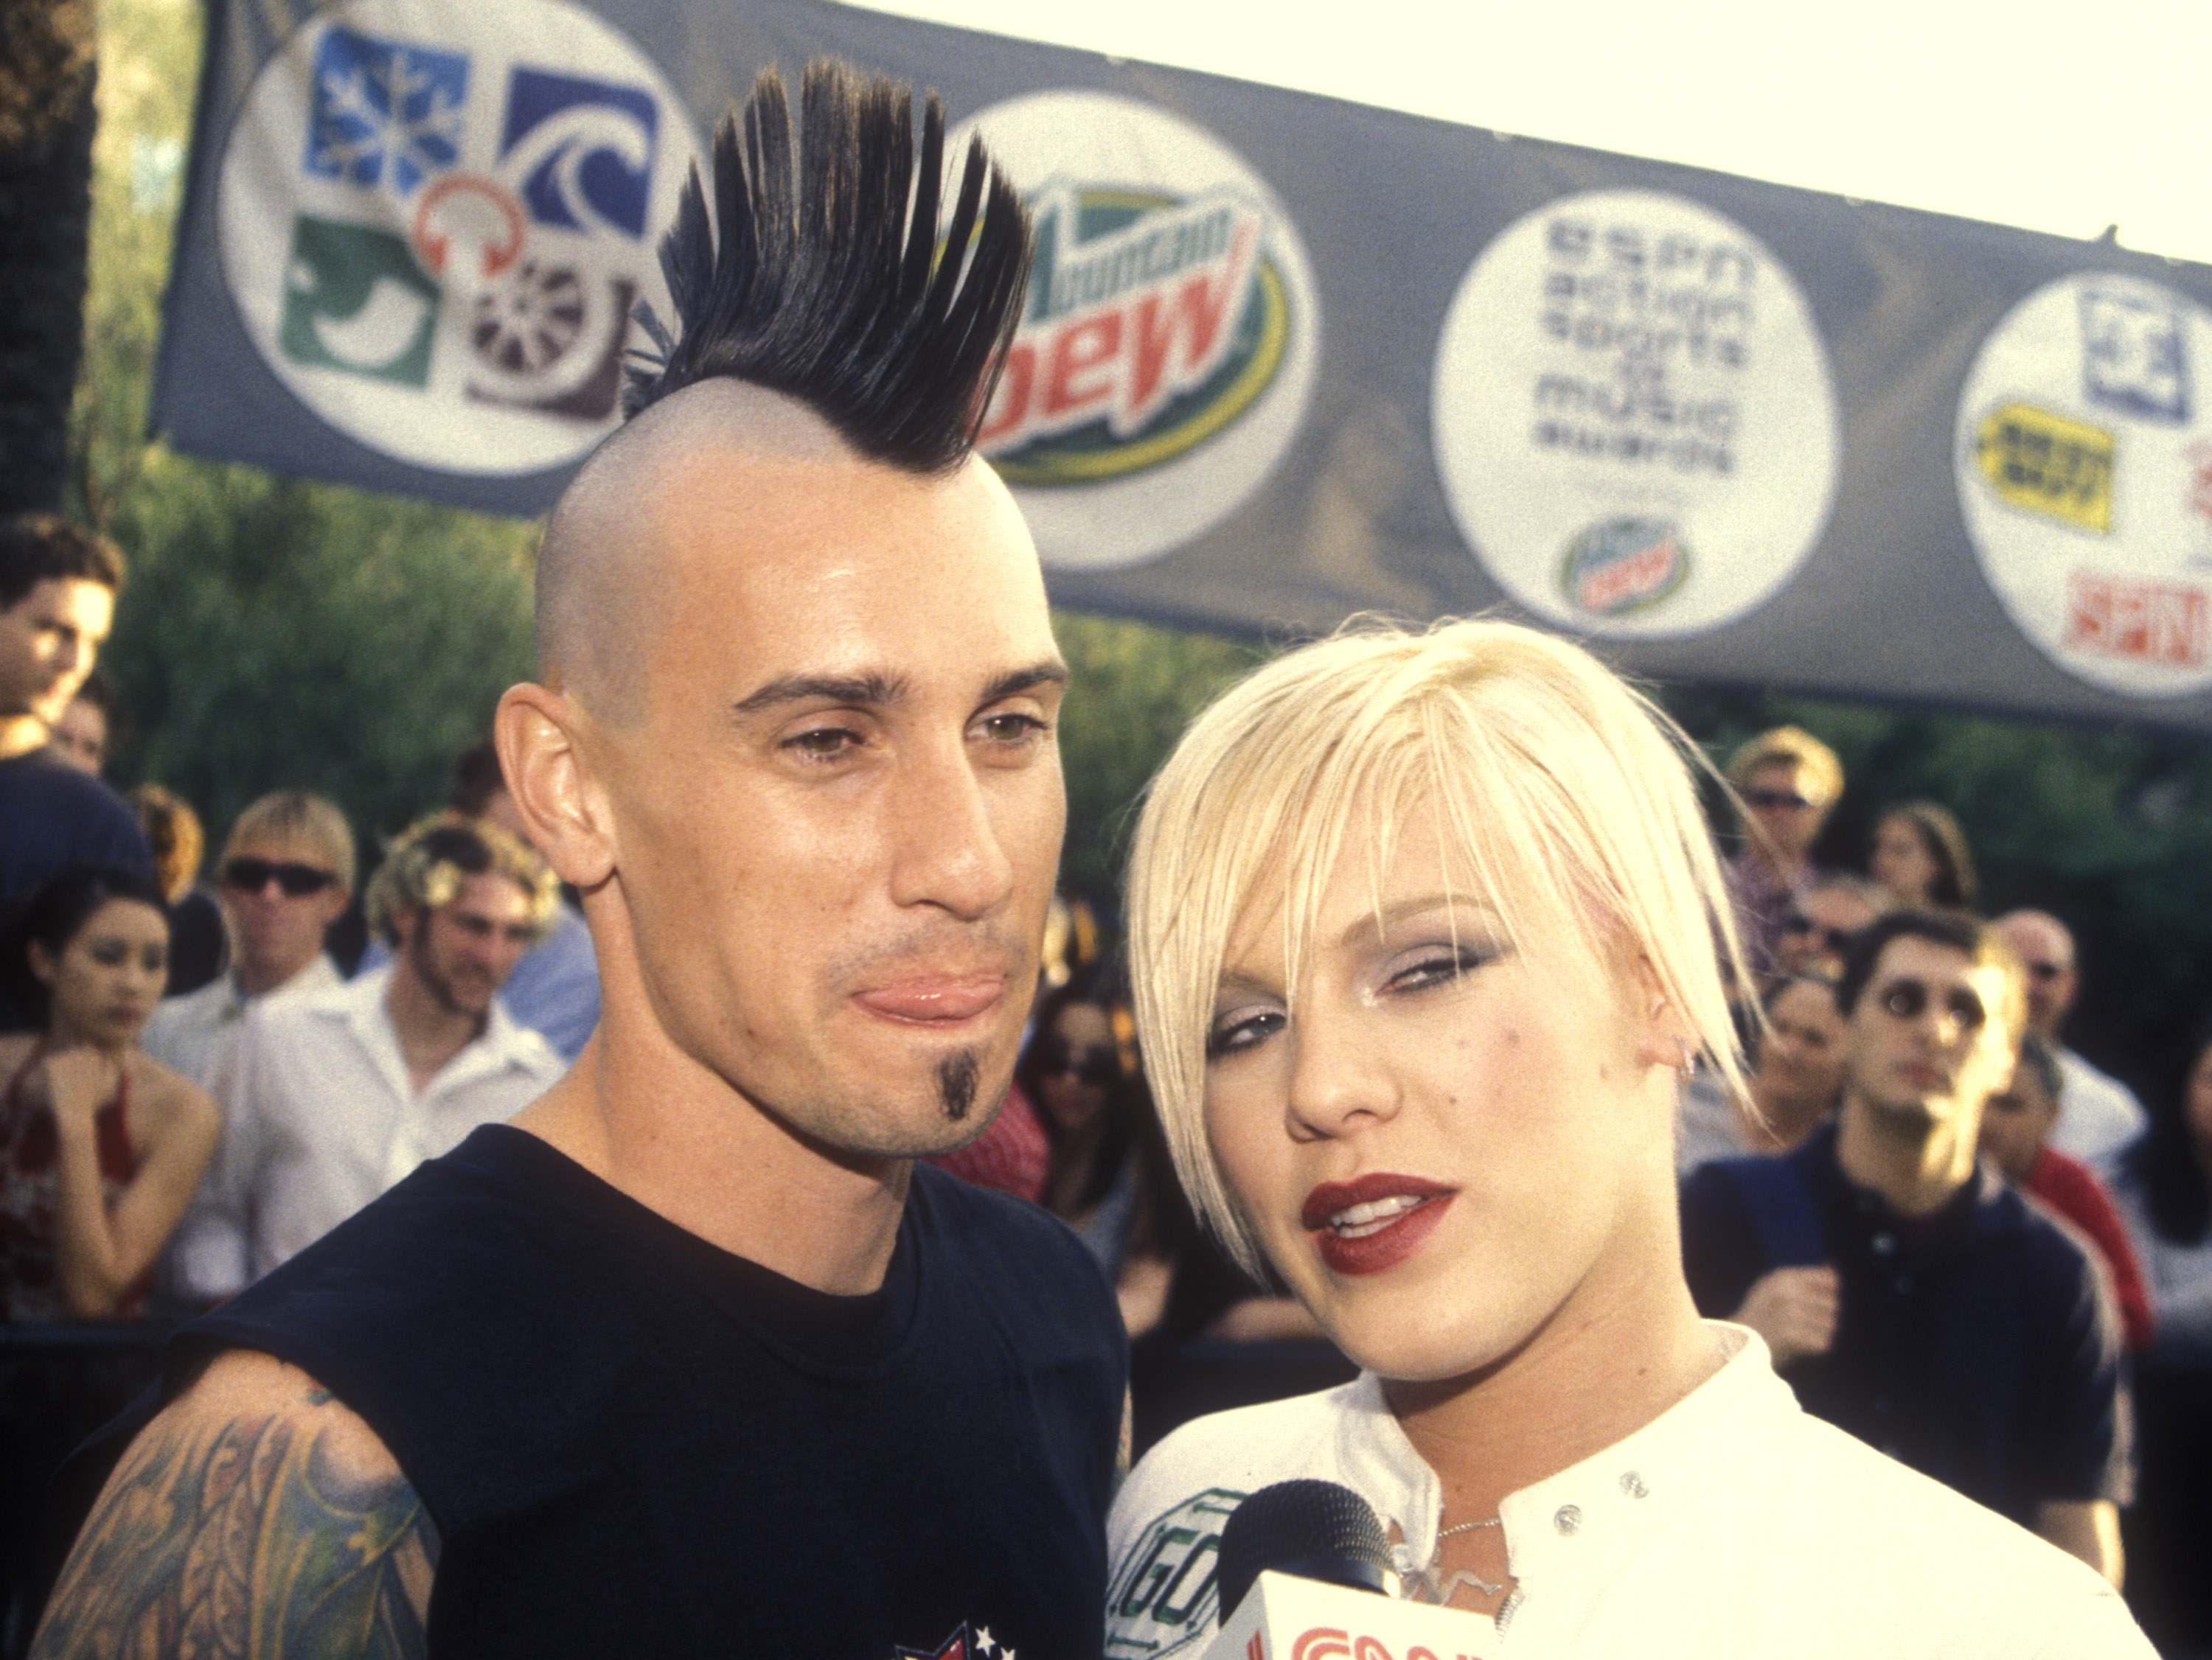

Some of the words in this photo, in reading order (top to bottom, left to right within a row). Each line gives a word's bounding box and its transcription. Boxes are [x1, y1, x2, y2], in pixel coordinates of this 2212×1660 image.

[1544, 270, 1755, 326] action
[1538, 310, 1747, 369] sports
[1534, 372, 1740, 438] music
[1532, 419, 1736, 478] awards
